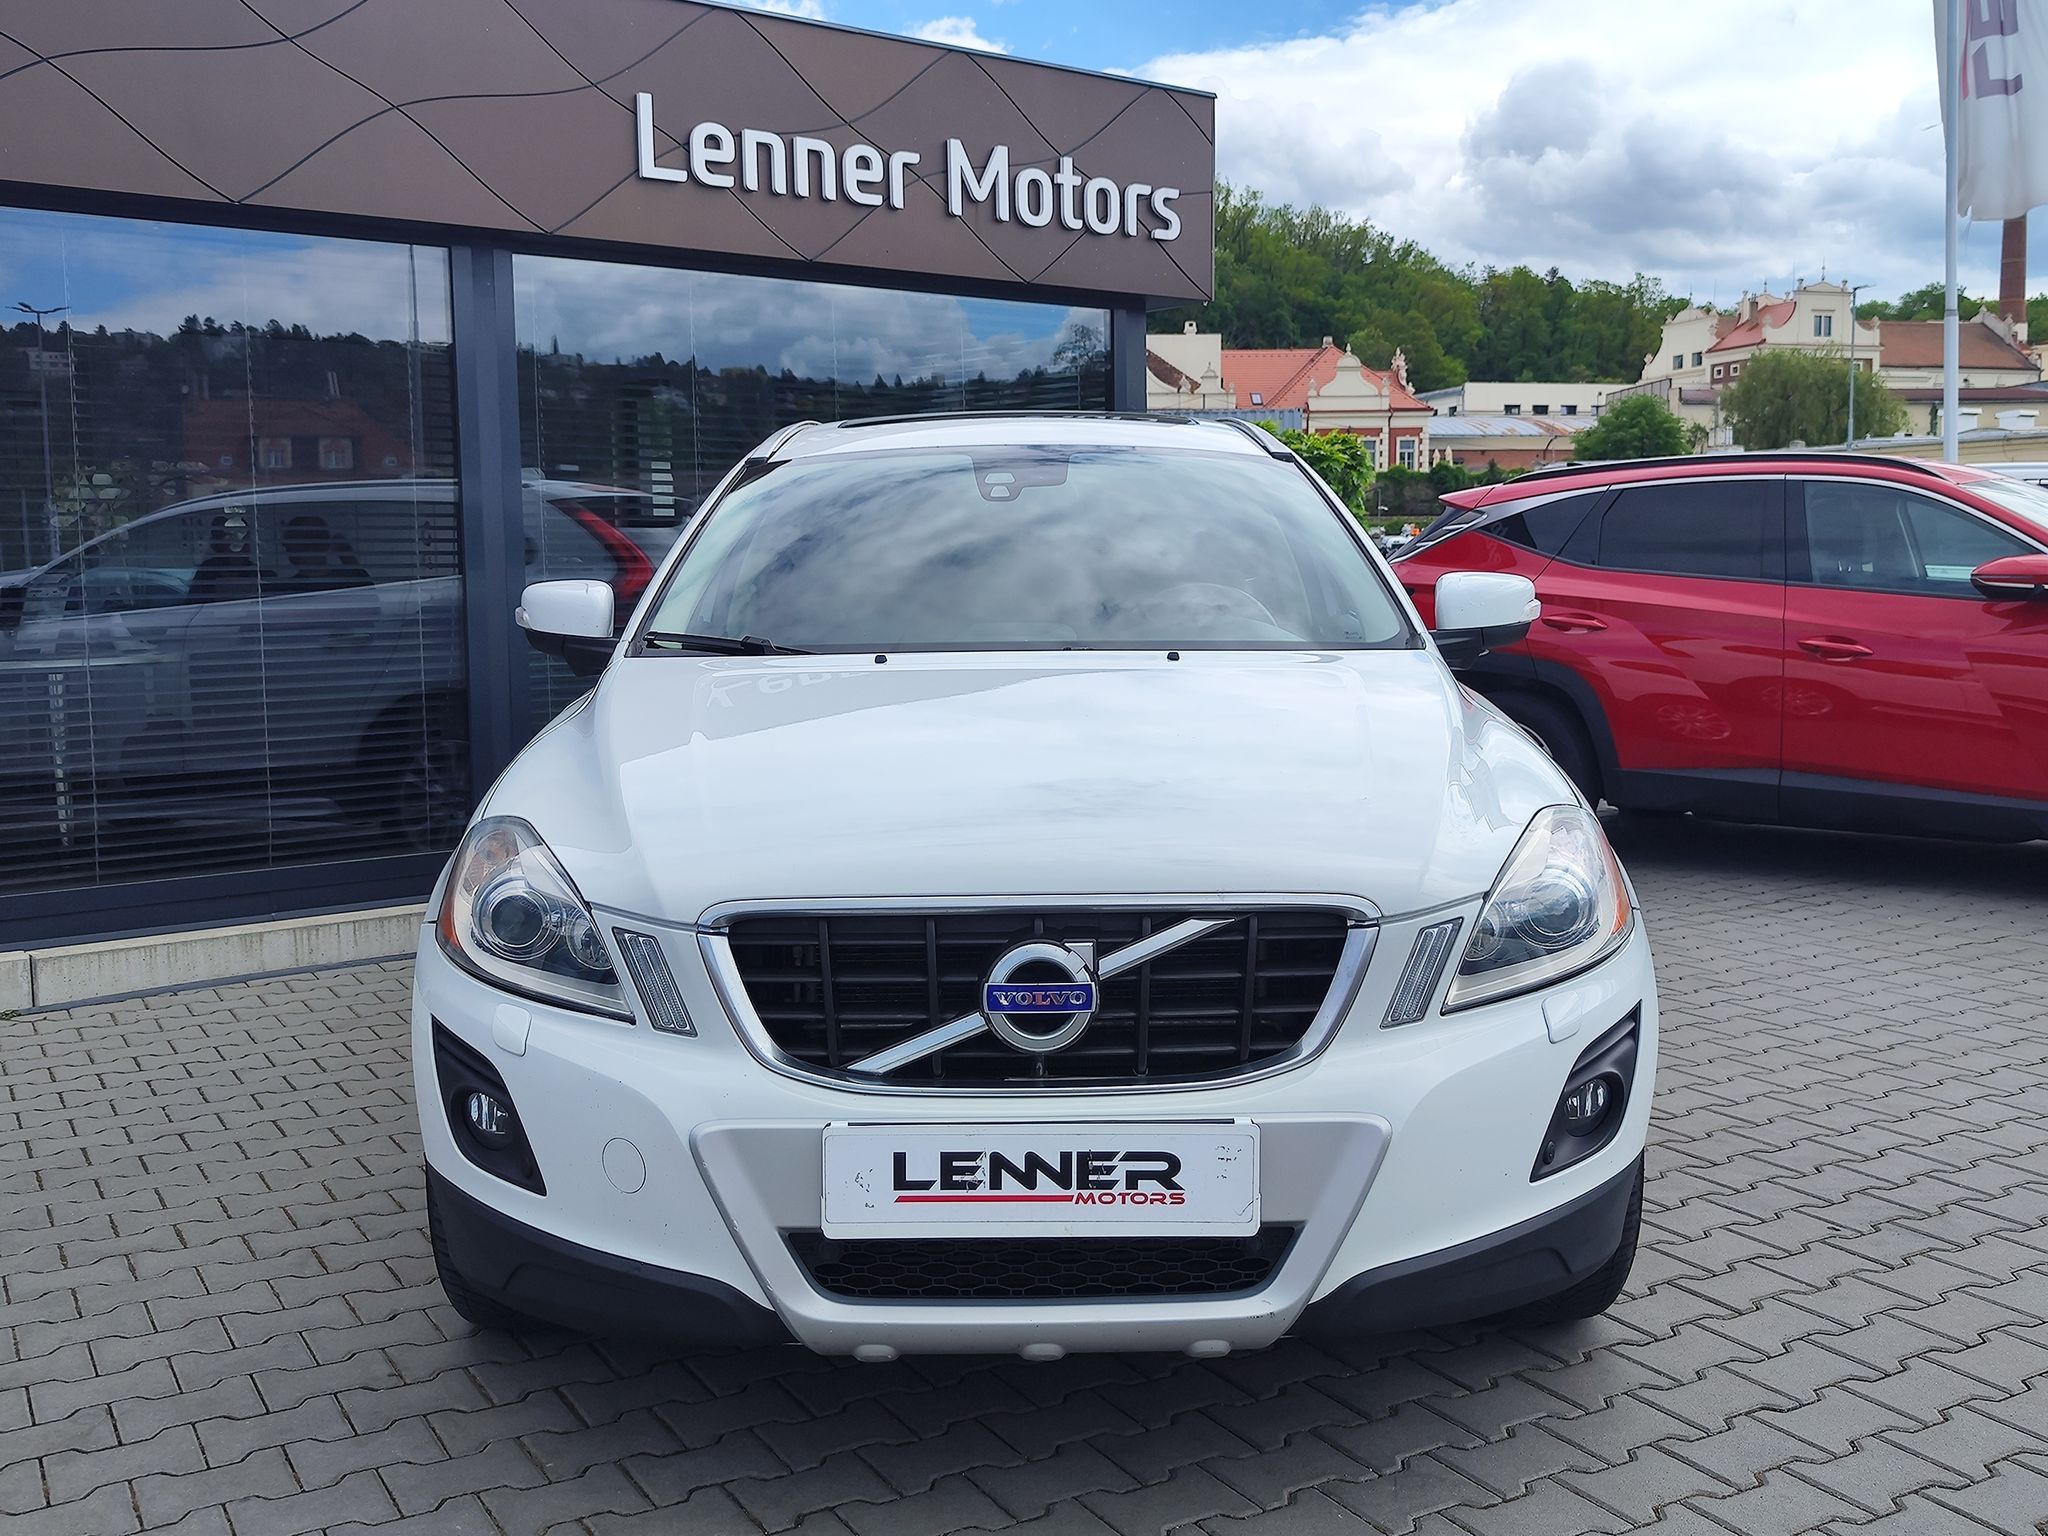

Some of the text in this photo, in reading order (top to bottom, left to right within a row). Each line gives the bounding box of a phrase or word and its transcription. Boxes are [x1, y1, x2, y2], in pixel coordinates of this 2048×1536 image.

[636, 91, 1182, 242] Lenner Motors
[992, 990, 1087, 1006] VOLVO
[892, 1150, 1186, 1191] LENNER
[1074, 1191, 1186, 1205] MOTORS
